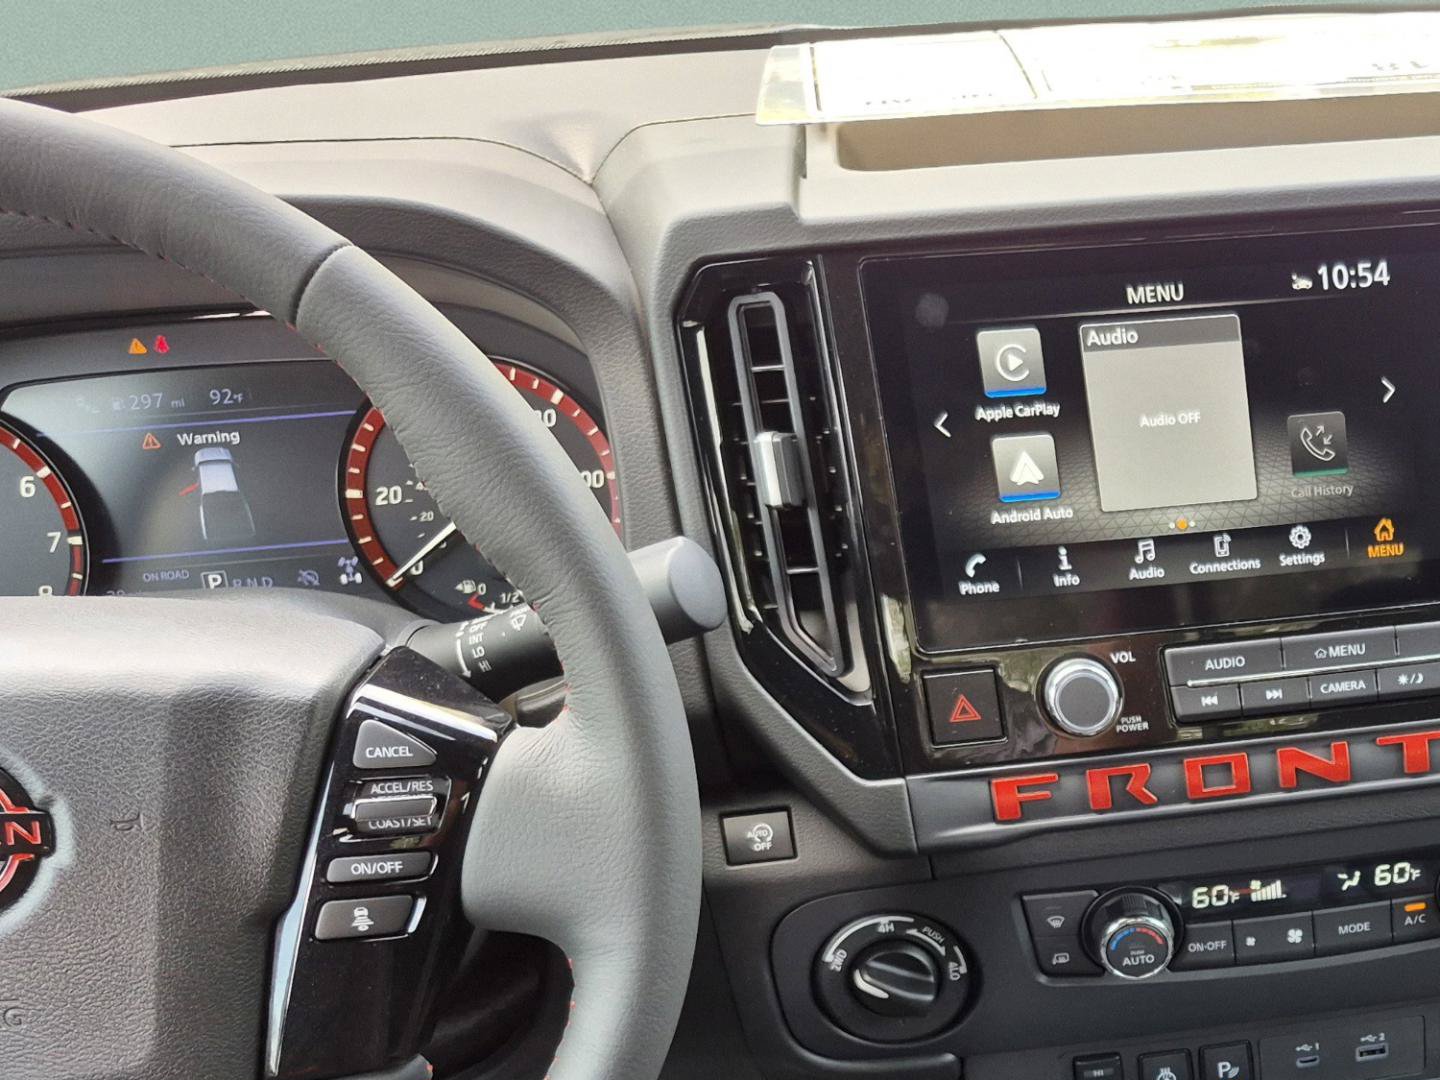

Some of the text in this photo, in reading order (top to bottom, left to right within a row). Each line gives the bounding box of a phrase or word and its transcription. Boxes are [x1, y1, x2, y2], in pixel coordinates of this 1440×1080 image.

[1317, 260, 1391, 291] 10:54
[1126, 283, 1185, 305] MENU
[1087, 326, 1139, 347] Audio
[130, 393, 163, 409] 297
[975, 401, 1060, 422] Apple CarPlay
[1140, 410, 1201, 428] Audio OFF
[177, 431, 240, 446] Warning
[20, 475, 36, 498] 6
[1291, 482, 1354, 500] Call History
[375, 486, 403, 506] 20
[419, 511, 434, 522] 20
[991, 506, 1074, 525] Android Auto
[47, 531, 61, 553] 7
[1367, 541, 1404, 559] MENU
[1190, 556, 1261, 575] Connections
[1280, 549, 1326, 568] Settings
[143, 570, 190, 582] ON ROAD
[208, 574, 222, 589] P
[1053, 573, 1080, 587] Info
[1129, 567, 1165, 582] Audio
[478, 583, 487, 595] 0
[959, 579, 1000, 596] Phone
[500, 593, 520, 604] 1/2
[469, 633, 484, 644] INT
[472, 646, 485, 659] LO
[1109, 651, 1136, 664] VOL
[1328, 643, 1366, 658] MENU
[478, 659, 493, 673] HI
[1204, 656, 1246, 671] AUDIO
[1320, 680, 1366, 694] CAMERA
[1115, 721, 1150, 733] POWER
[1120, 715, 1142, 725] PUSH
[365, 745, 413, 759] CANCEL
[371, 779, 434, 795] ACCEL/RES
[368, 817, 433, 830] COAST/SET
[747, 828, 768, 839] AUTO
[753, 841, 772, 852] OFF
[350, 860, 404, 876] ON/OFF
[1404, 913, 1426, 926] A/C
[877, 922, 895, 934] 4H
[921, 925, 946, 945] PUSH
[1338, 921, 1371, 935] MODE
[829, 949, 848, 973] 2WD
[1122, 953, 1155, 968] AUTO
[1379, 1032, 1386, 1042] 2
[1315, 1041, 1320, 1050] 1
[1217, 1061, 1231, 1079] P
